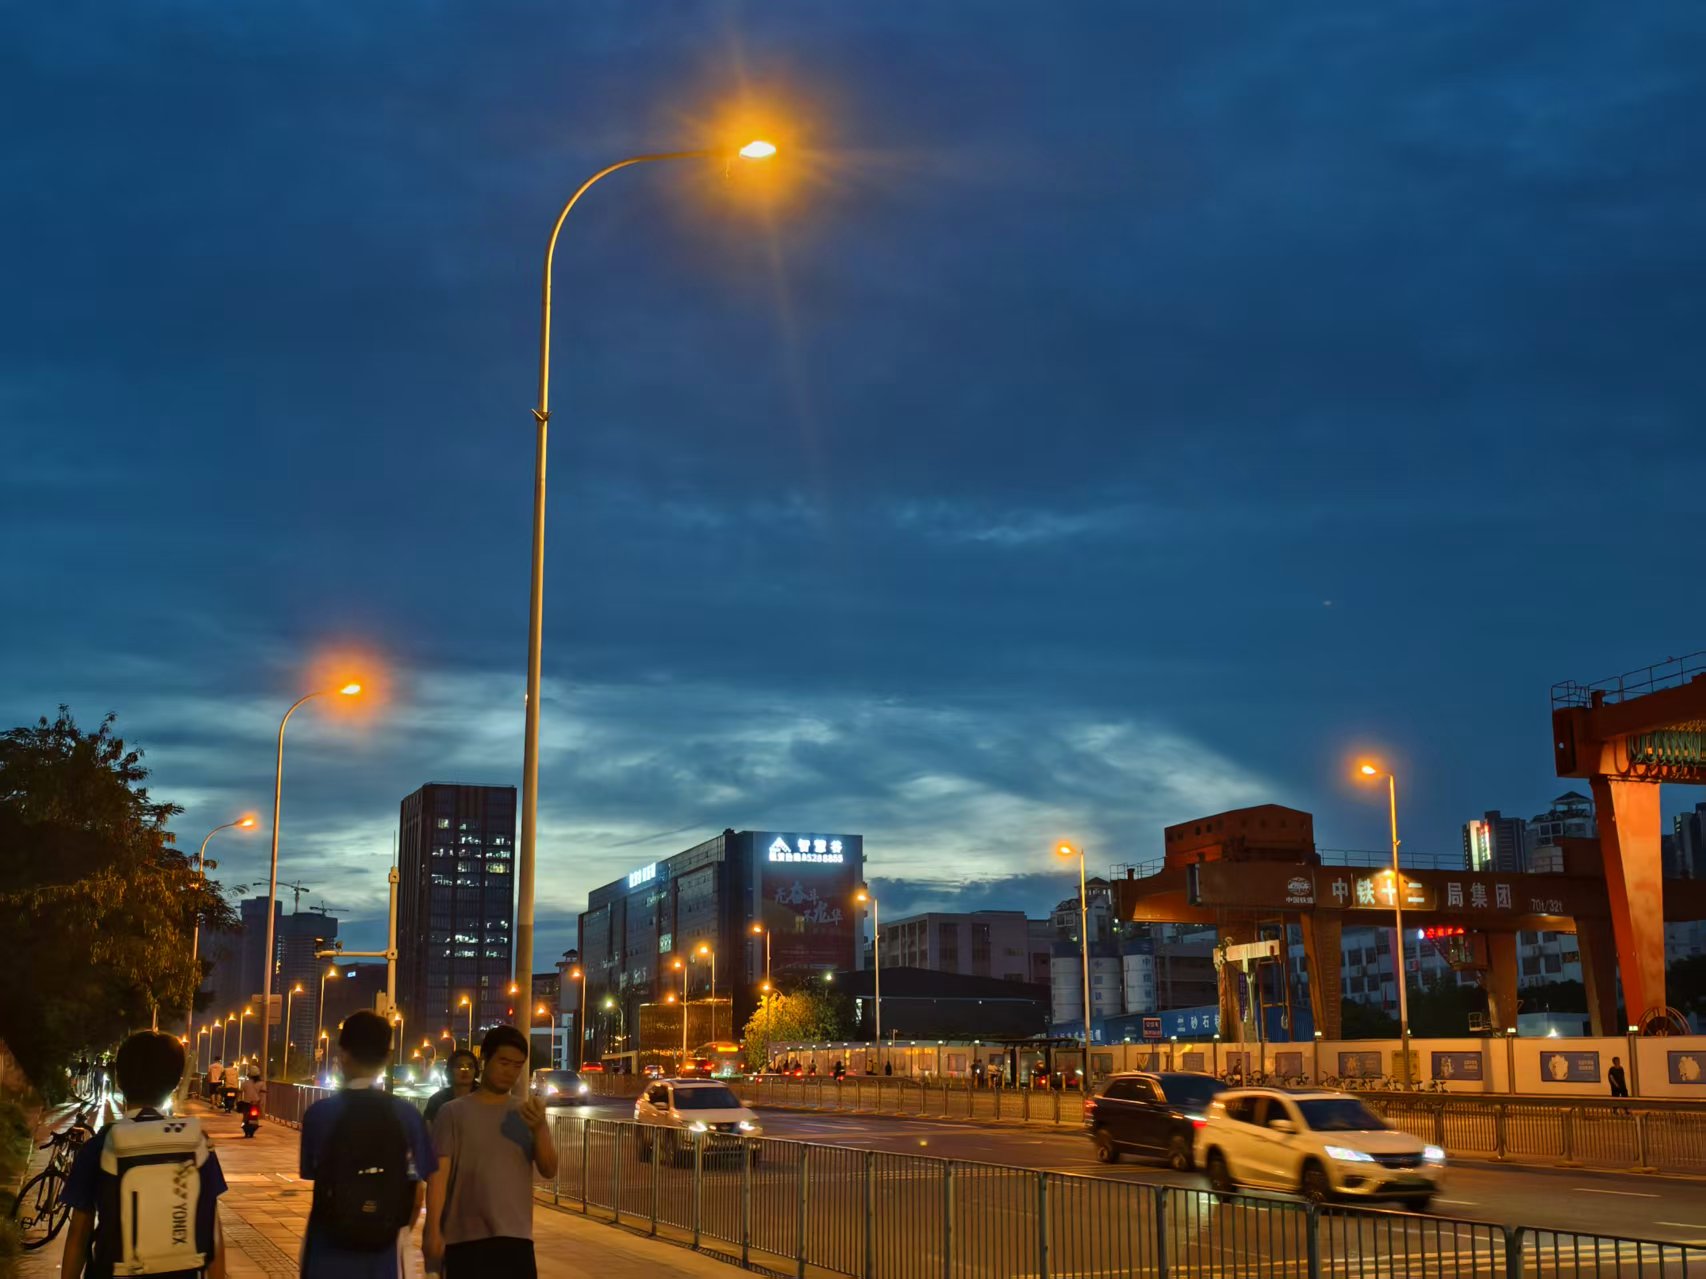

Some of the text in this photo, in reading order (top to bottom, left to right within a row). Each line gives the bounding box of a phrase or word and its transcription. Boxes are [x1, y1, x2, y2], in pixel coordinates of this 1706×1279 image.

[1331, 877, 1512, 909] 中铁十二局集团
[172, 1202, 188, 1245] YONEX
